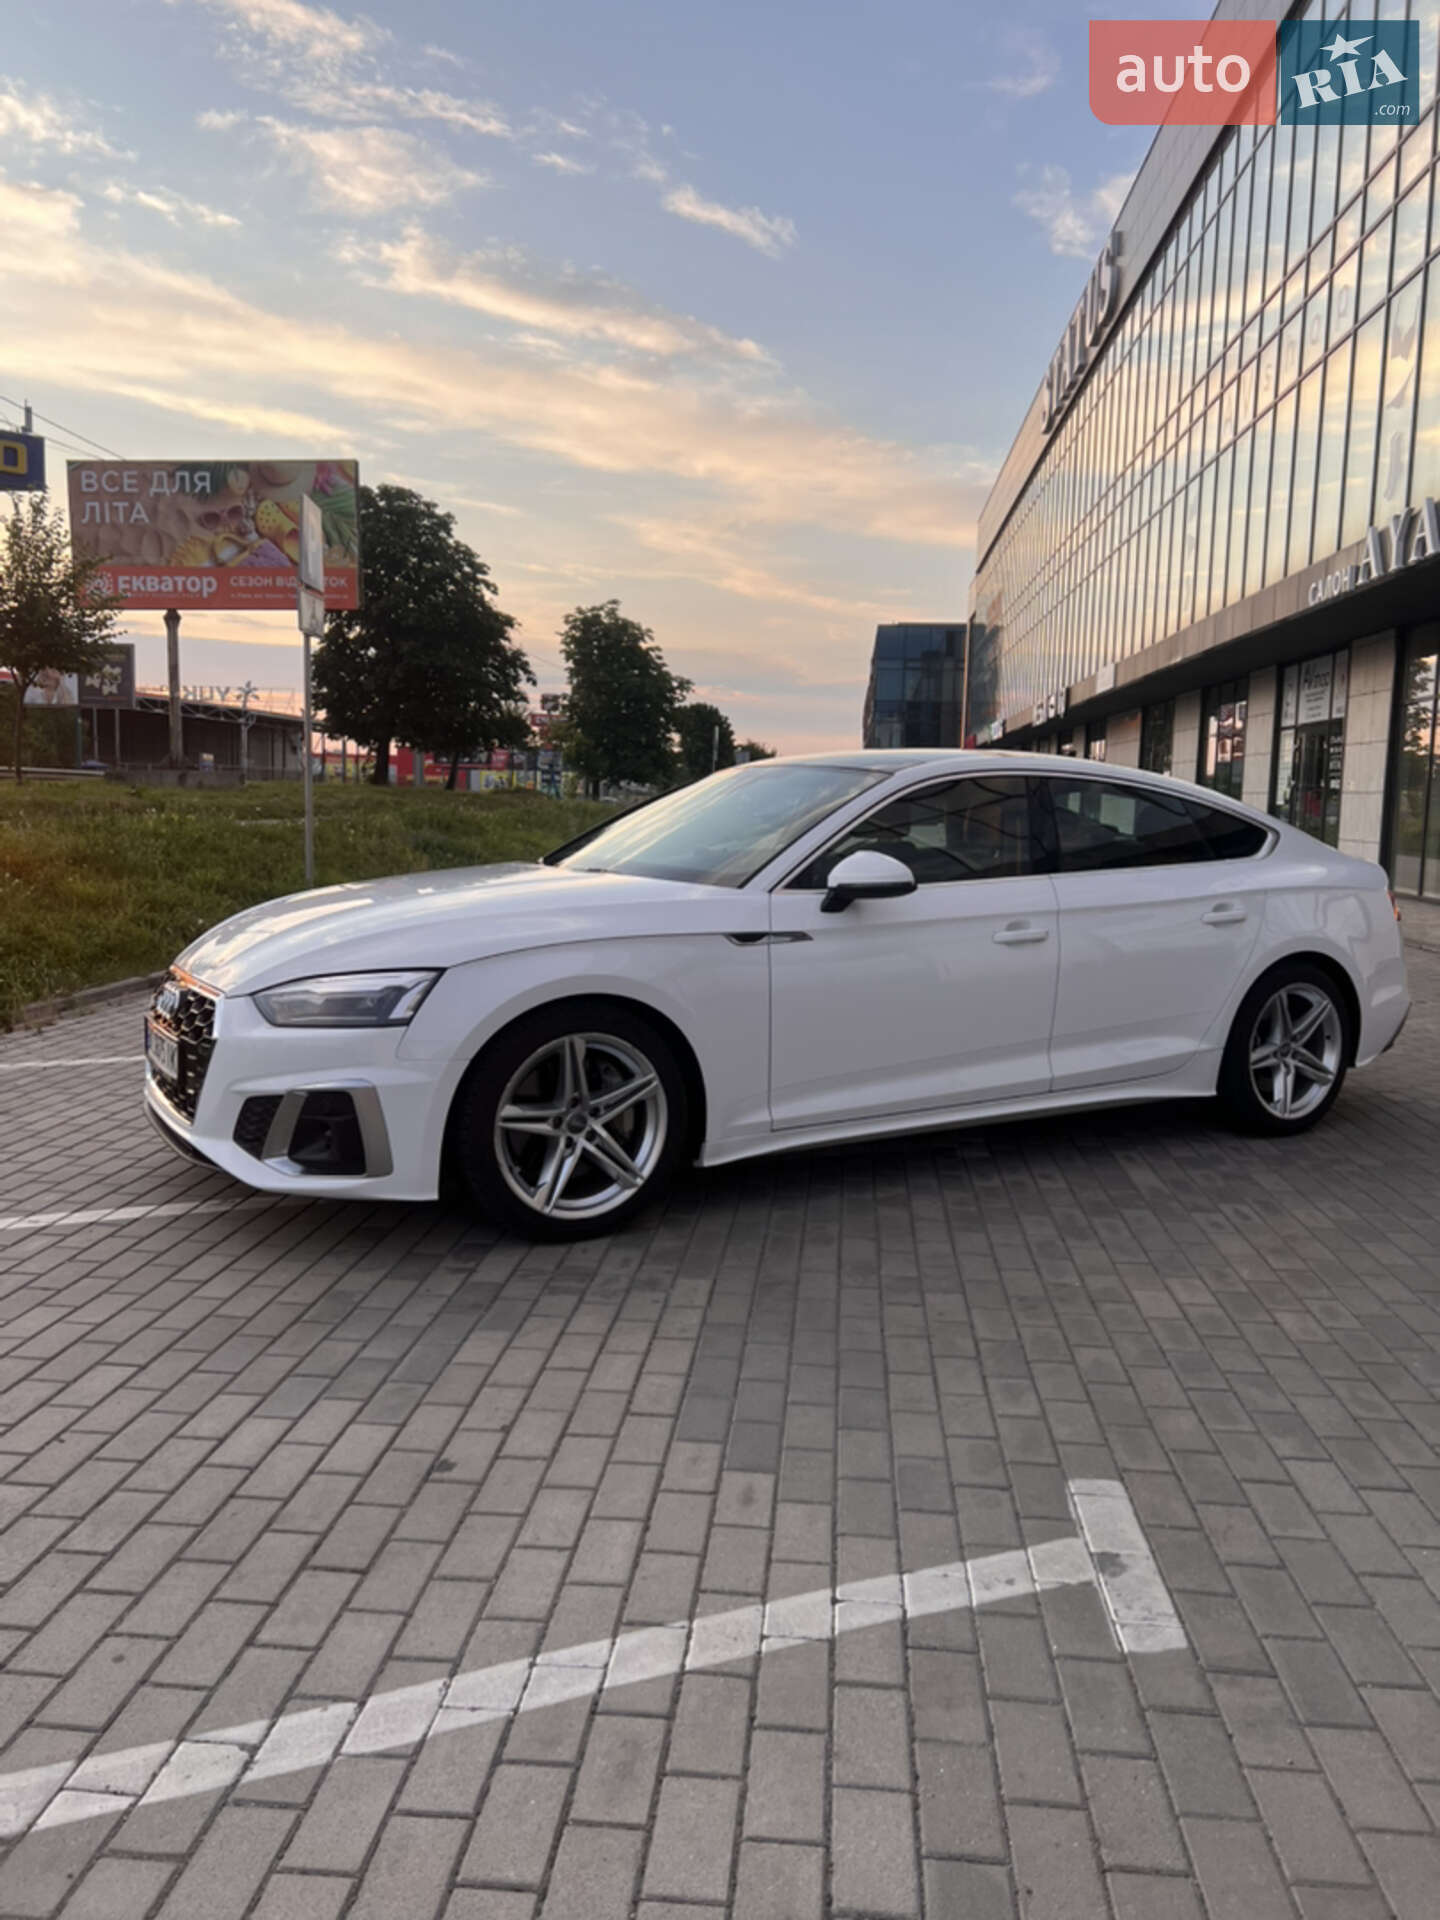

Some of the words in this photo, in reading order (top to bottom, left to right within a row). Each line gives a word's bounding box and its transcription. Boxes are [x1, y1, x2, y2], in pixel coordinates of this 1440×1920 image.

[81, 470, 139, 493] ВСЕ
[149, 470, 211, 497] ДЛЯ
[81, 501, 150, 524] ЛІТА
[230, 576, 273, 587] СЕЗОН
[276, 576, 348, 588] ВІДТОК
